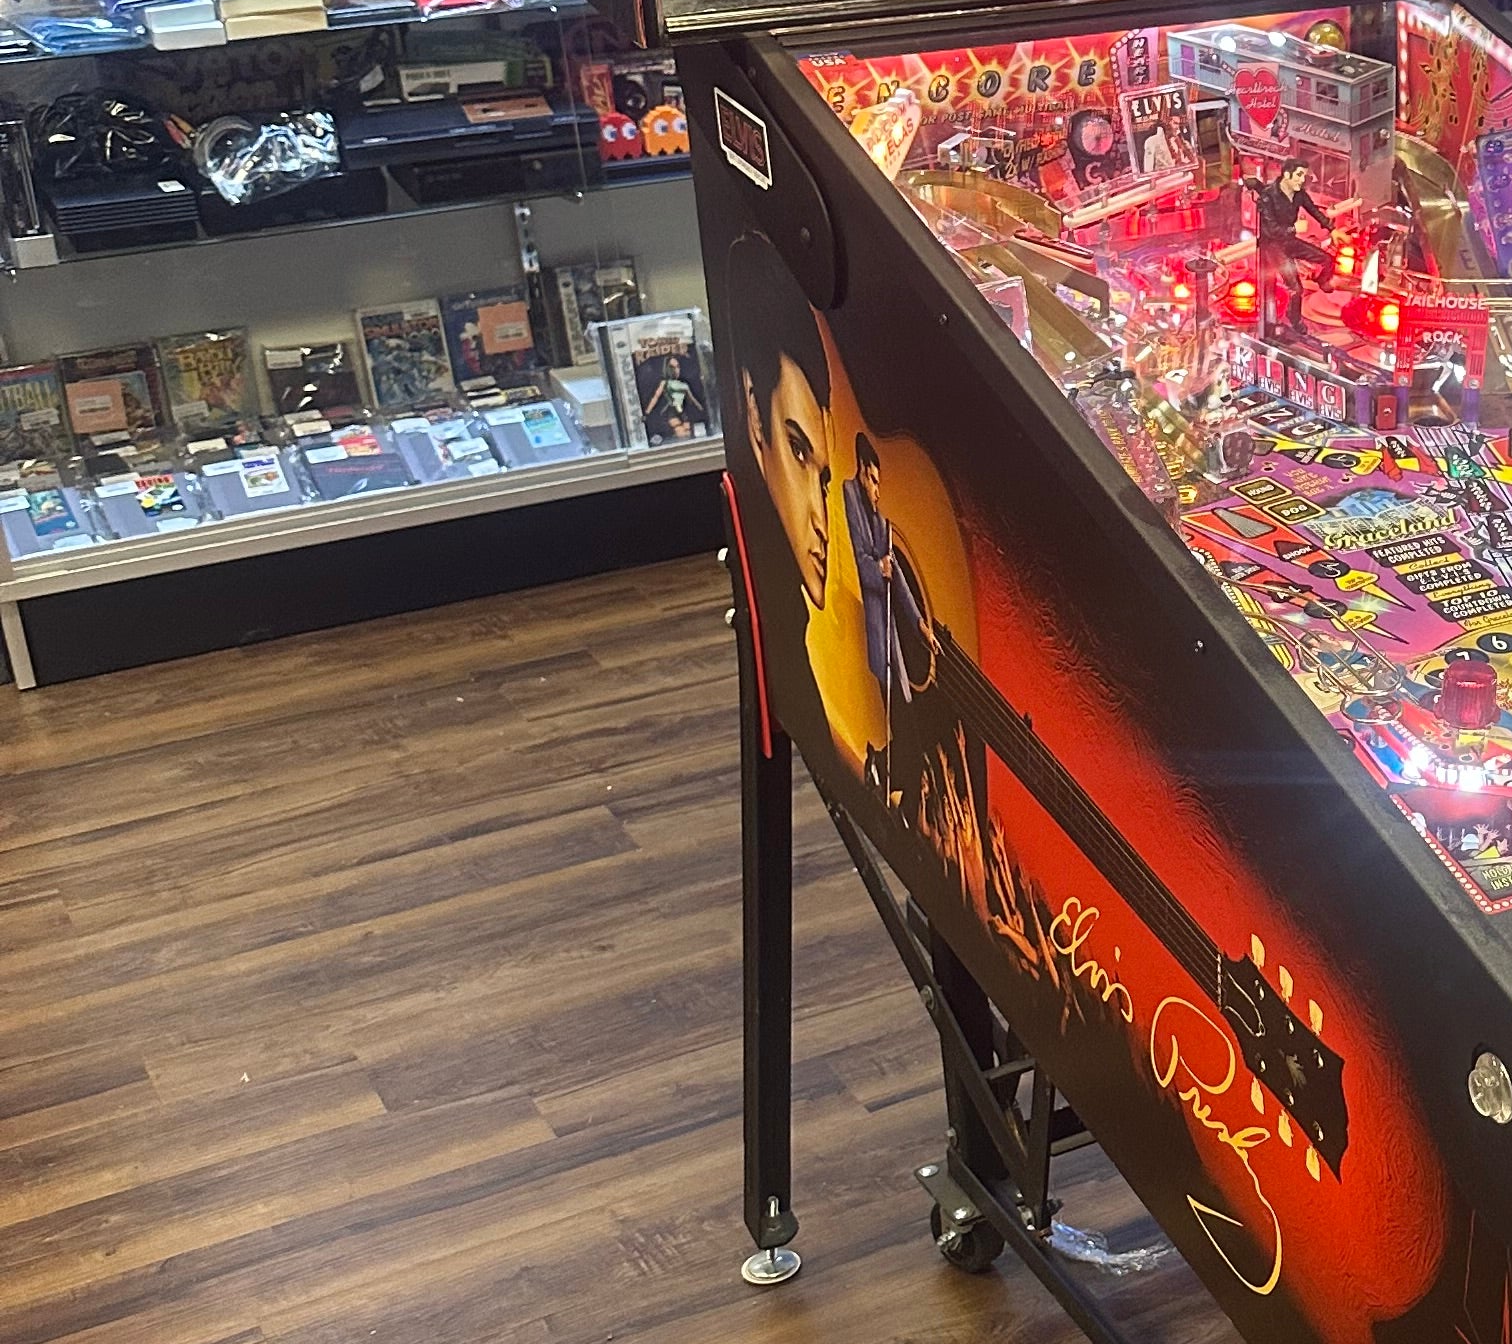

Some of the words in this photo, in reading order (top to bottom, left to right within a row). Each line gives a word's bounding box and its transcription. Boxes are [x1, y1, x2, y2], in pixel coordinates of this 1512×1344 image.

[811, 57, 847, 68] USA
[1130, 91, 1183, 118] ELVIS
[1405, 294, 1486, 310] JAILHOUSE
[1422, 330, 1464, 345] ROCK
[1247, 483, 1276, 497] HOUND
[1280, 503, 1308, 517] DOG
[1323, 507, 1457, 551] Graceland
[1282, 545, 1314, 561] SHOOK
[1372, 541, 1421, 559] FEATURED
[1423, 536, 1446, 549] HITS
[1388, 546, 1443, 565] COMPLETED
[1406, 568, 1438, 582] GIFTS
[1440, 561, 1473, 575] FROM
[1408, 556, 1450, 570] Collect
[1420, 572, 1482, 592] COMPLETED
[1432, 580, 1492, 599] Everything
[1441, 593, 1470, 607] TOP
[1479, 588, 1499, 601] 10
[1443, 593, 1511, 614] COUNTDOWN
[1491, 635, 1508, 652] 6
[1482, 865, 1511, 881] HOLD
[1049, 895, 1134, 1024] Elvis
